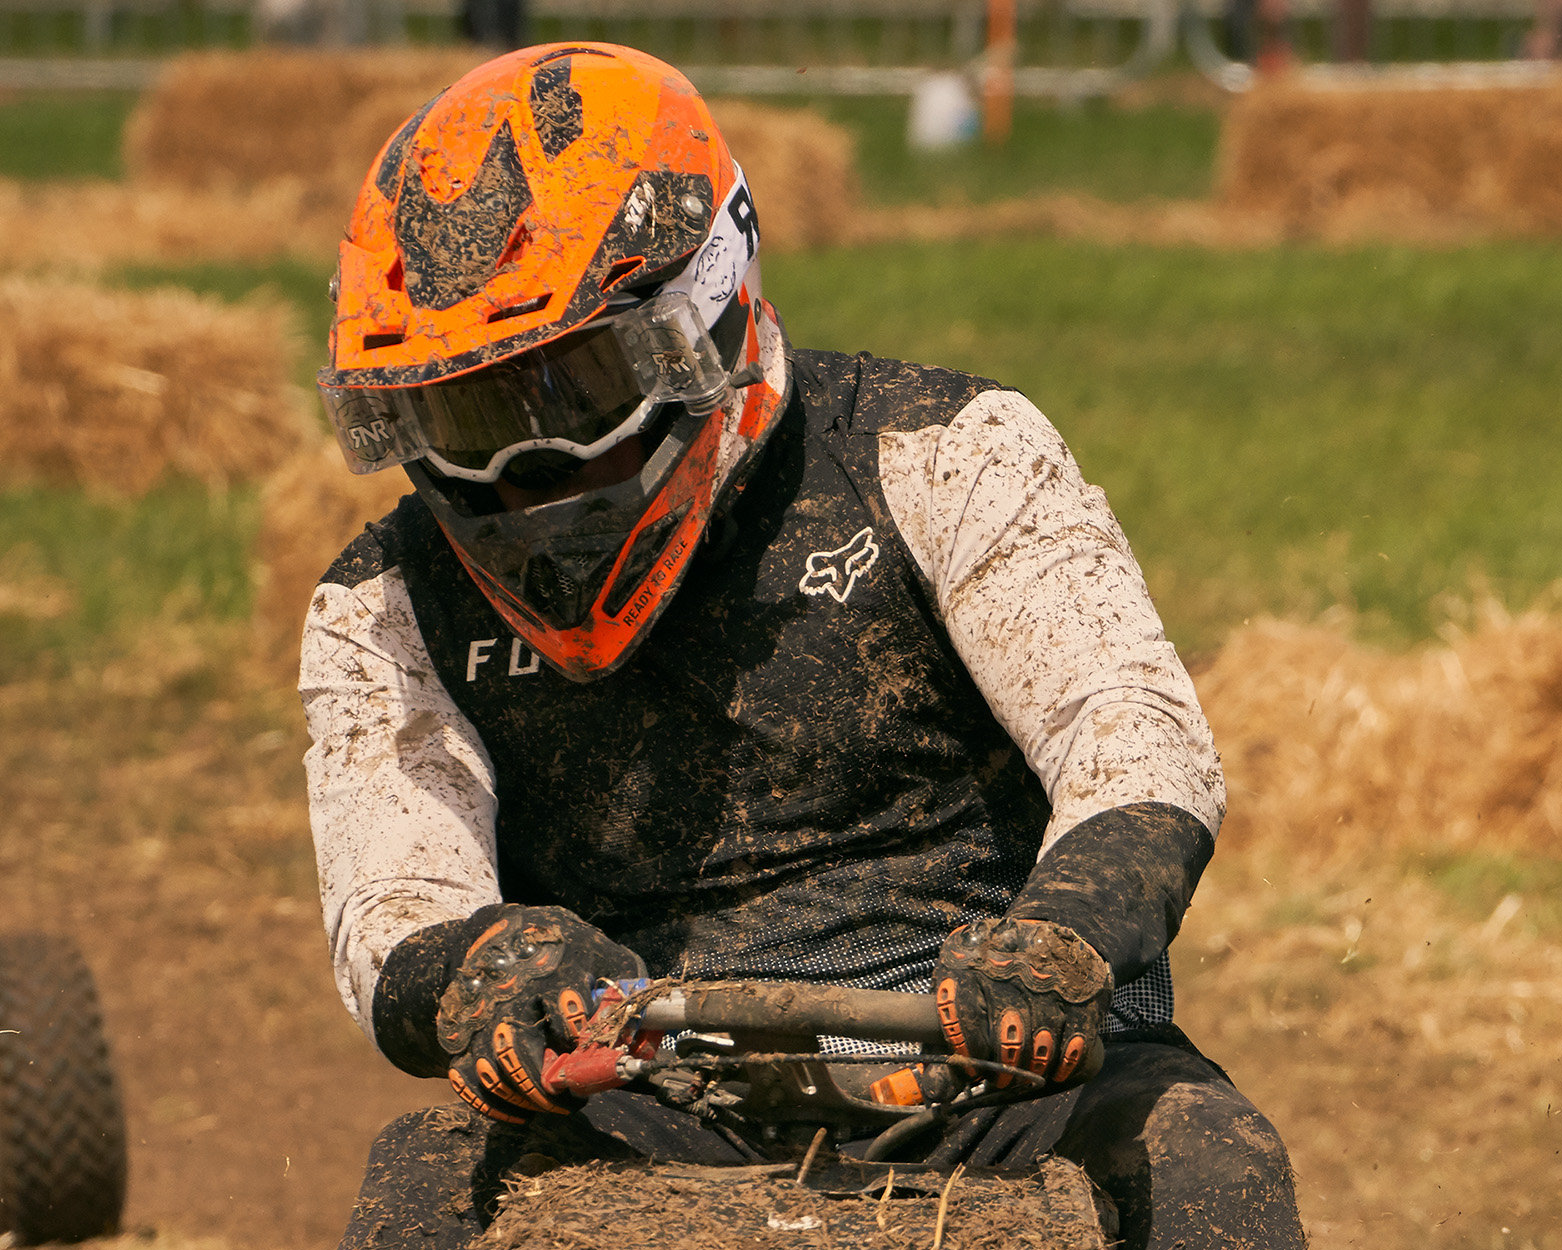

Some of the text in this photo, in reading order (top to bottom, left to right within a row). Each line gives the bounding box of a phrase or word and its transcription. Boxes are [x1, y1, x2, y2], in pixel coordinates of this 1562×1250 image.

[622, 586, 654, 627] READY
[663, 540, 688, 570] RACE
[466, 638, 540, 682] FO
